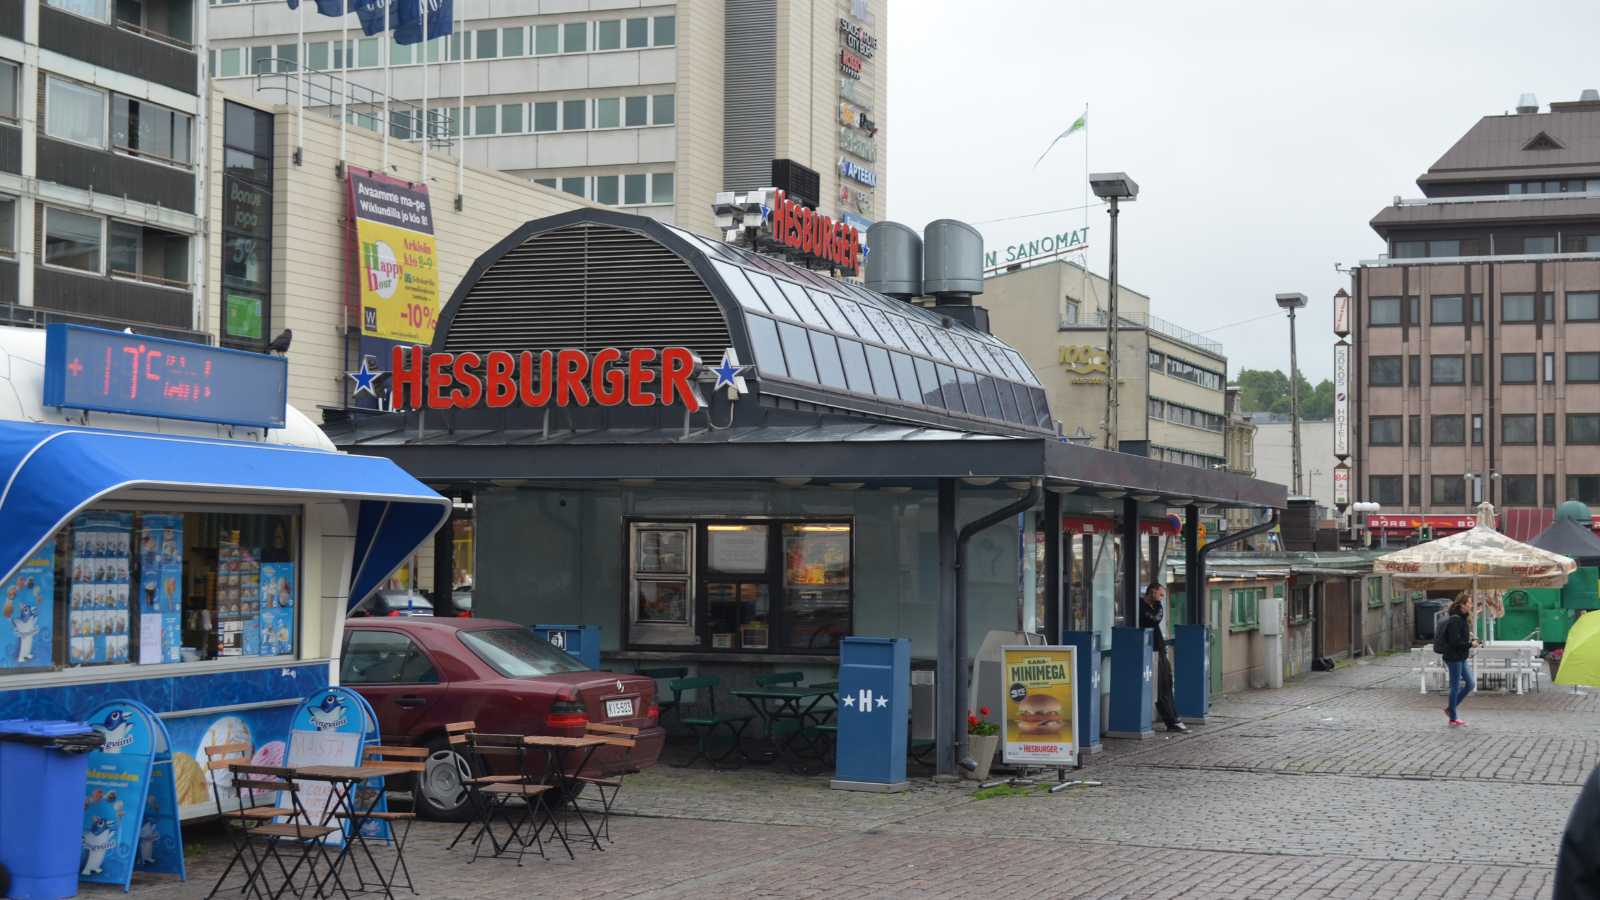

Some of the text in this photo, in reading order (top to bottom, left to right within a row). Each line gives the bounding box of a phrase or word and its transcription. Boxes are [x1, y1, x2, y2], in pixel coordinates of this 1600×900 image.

[358, 182, 426, 211] Avaamme ma-pe
[360, 200, 401, 219] Wiklundilla
[401, 209, 409, 223] jo
[409, 211, 420, 224] klo
[773, 189, 860, 276] HESBURGER
[1006, 226, 1090, 262] SANOMAT
[367, 264, 393, 292] hour
[400, 303, 438, 330] -10%
[392, 345, 699, 413] HESBURGER
[1011, 664, 1066, 682] MINIMEGA
[859, 689, 872, 712] H
[1024, 744, 1058, 754] HESBURGER
